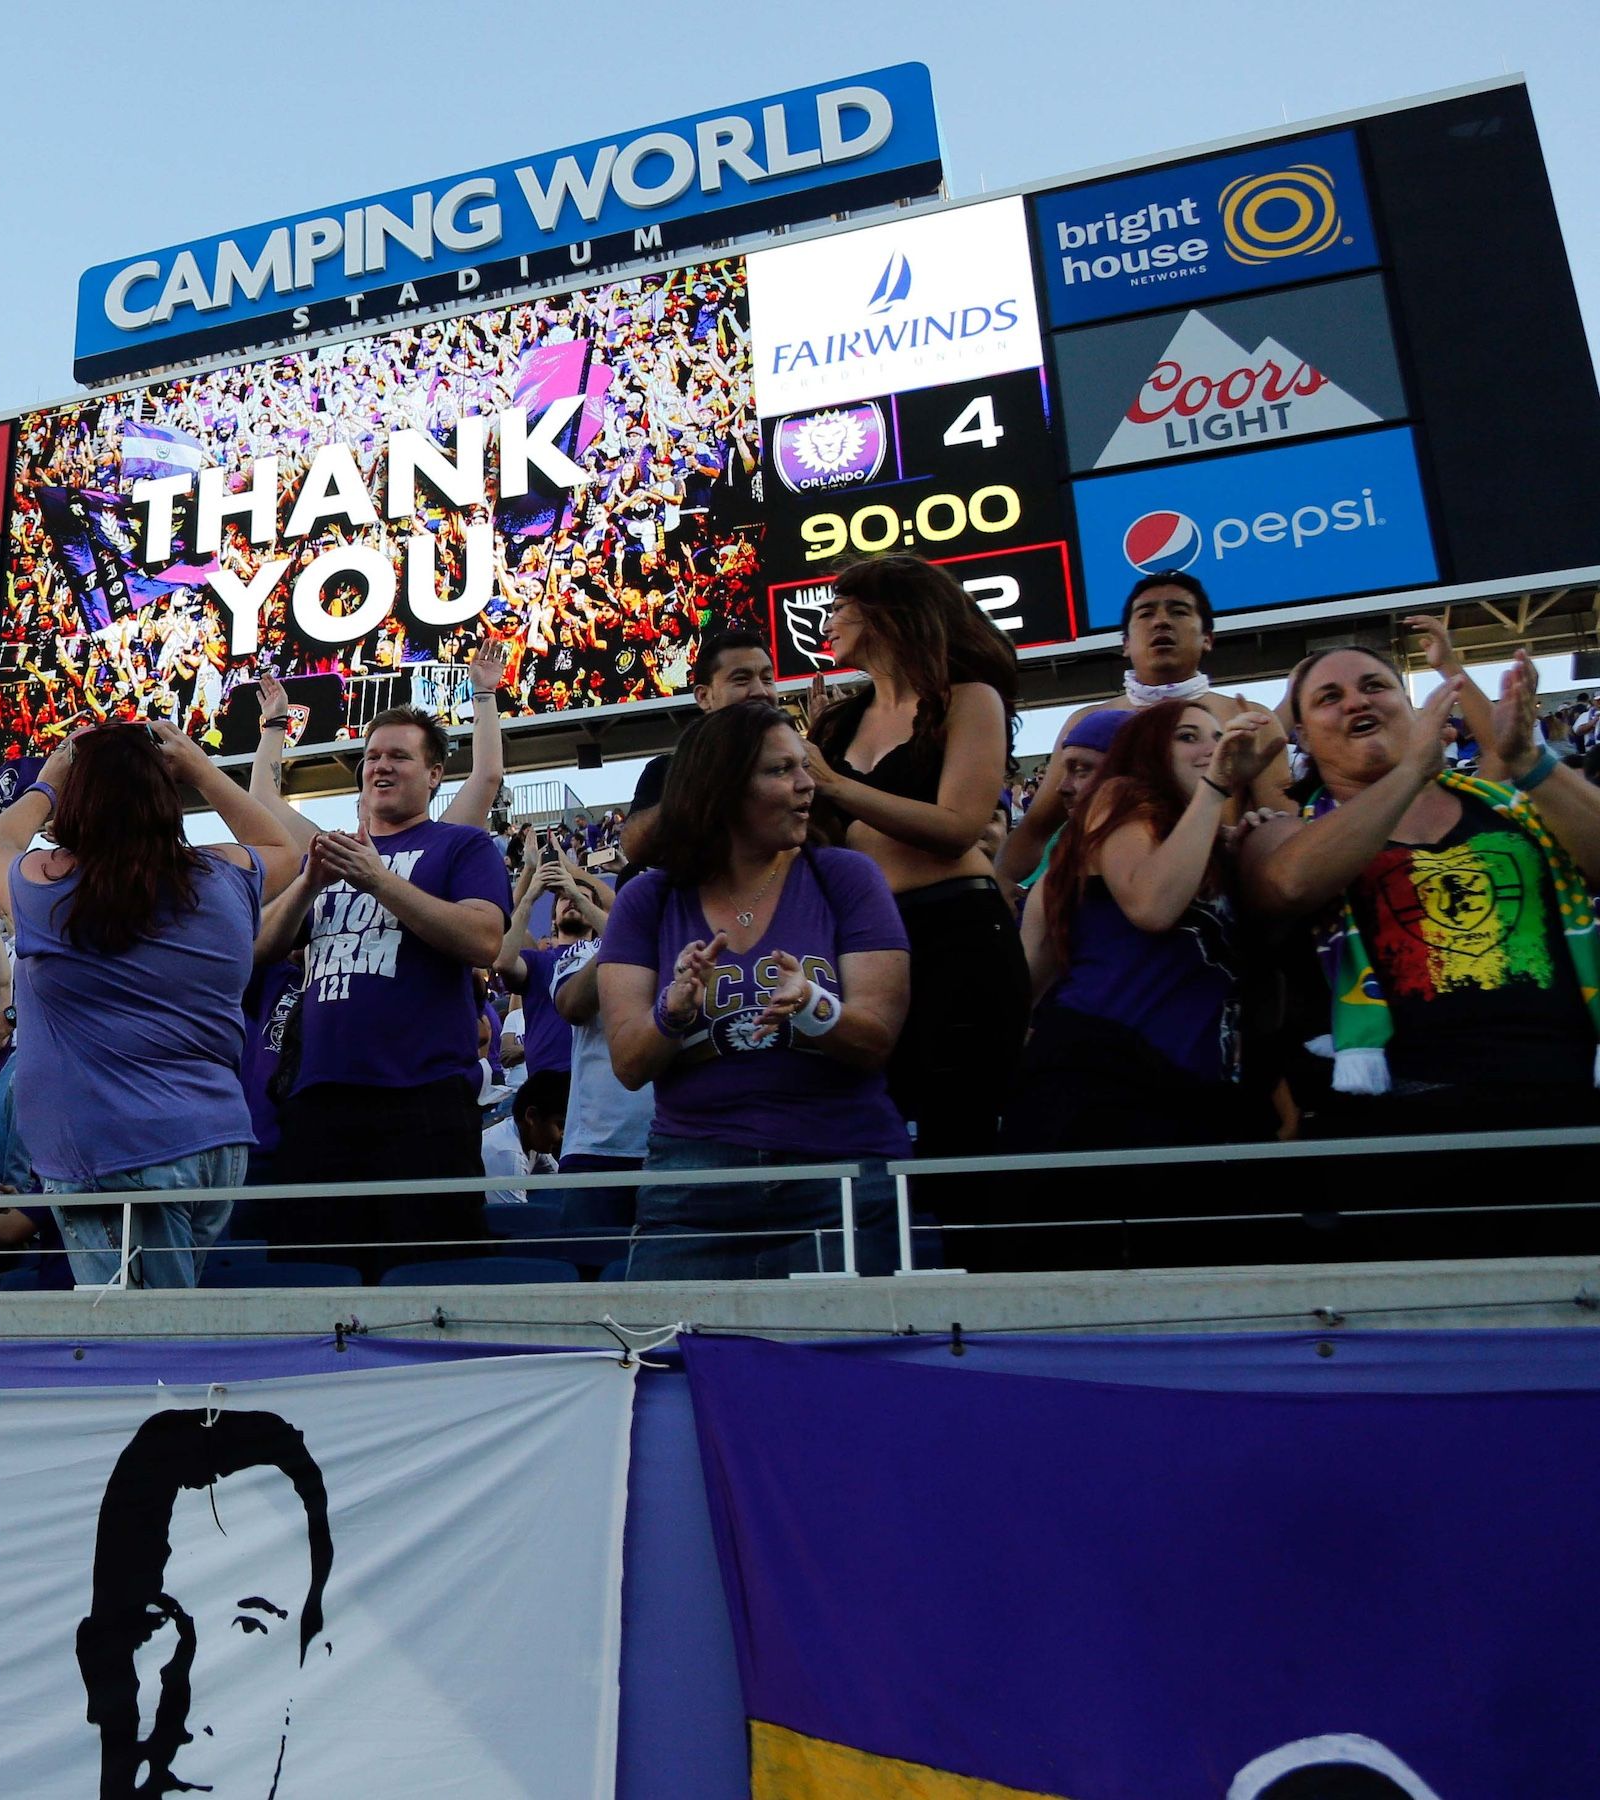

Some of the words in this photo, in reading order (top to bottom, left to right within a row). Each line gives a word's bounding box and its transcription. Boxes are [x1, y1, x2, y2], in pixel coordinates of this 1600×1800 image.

[102, 178, 502, 332] CAMPING
[514, 85, 894, 232] WORLD
[1056, 197, 1201, 251] bright
[292, 225, 663, 330] STADIUM
[1061, 238, 1209, 285] house
[1130, 264, 1208, 287] NETWORKS
[771, 299, 1019, 374] FAIRWINDS
[914, 340, 1008, 367] UNION
[943, 395, 1004, 449] 4
[1123, 360, 1330, 424] Coors
[1164, 401, 1292, 449] LIGHT
[132, 393, 594, 564] THANK
[800, 470, 865, 489] ORLANDO
[801, 485, 1021, 562] 90:00
[1212, 488, 1375, 560] pepsi
[205, 525, 495, 658] YOU
[963, 574, 1024, 630] 2
[318, 974, 350, 1002] 121
[703, 954, 840, 1021] CSC
